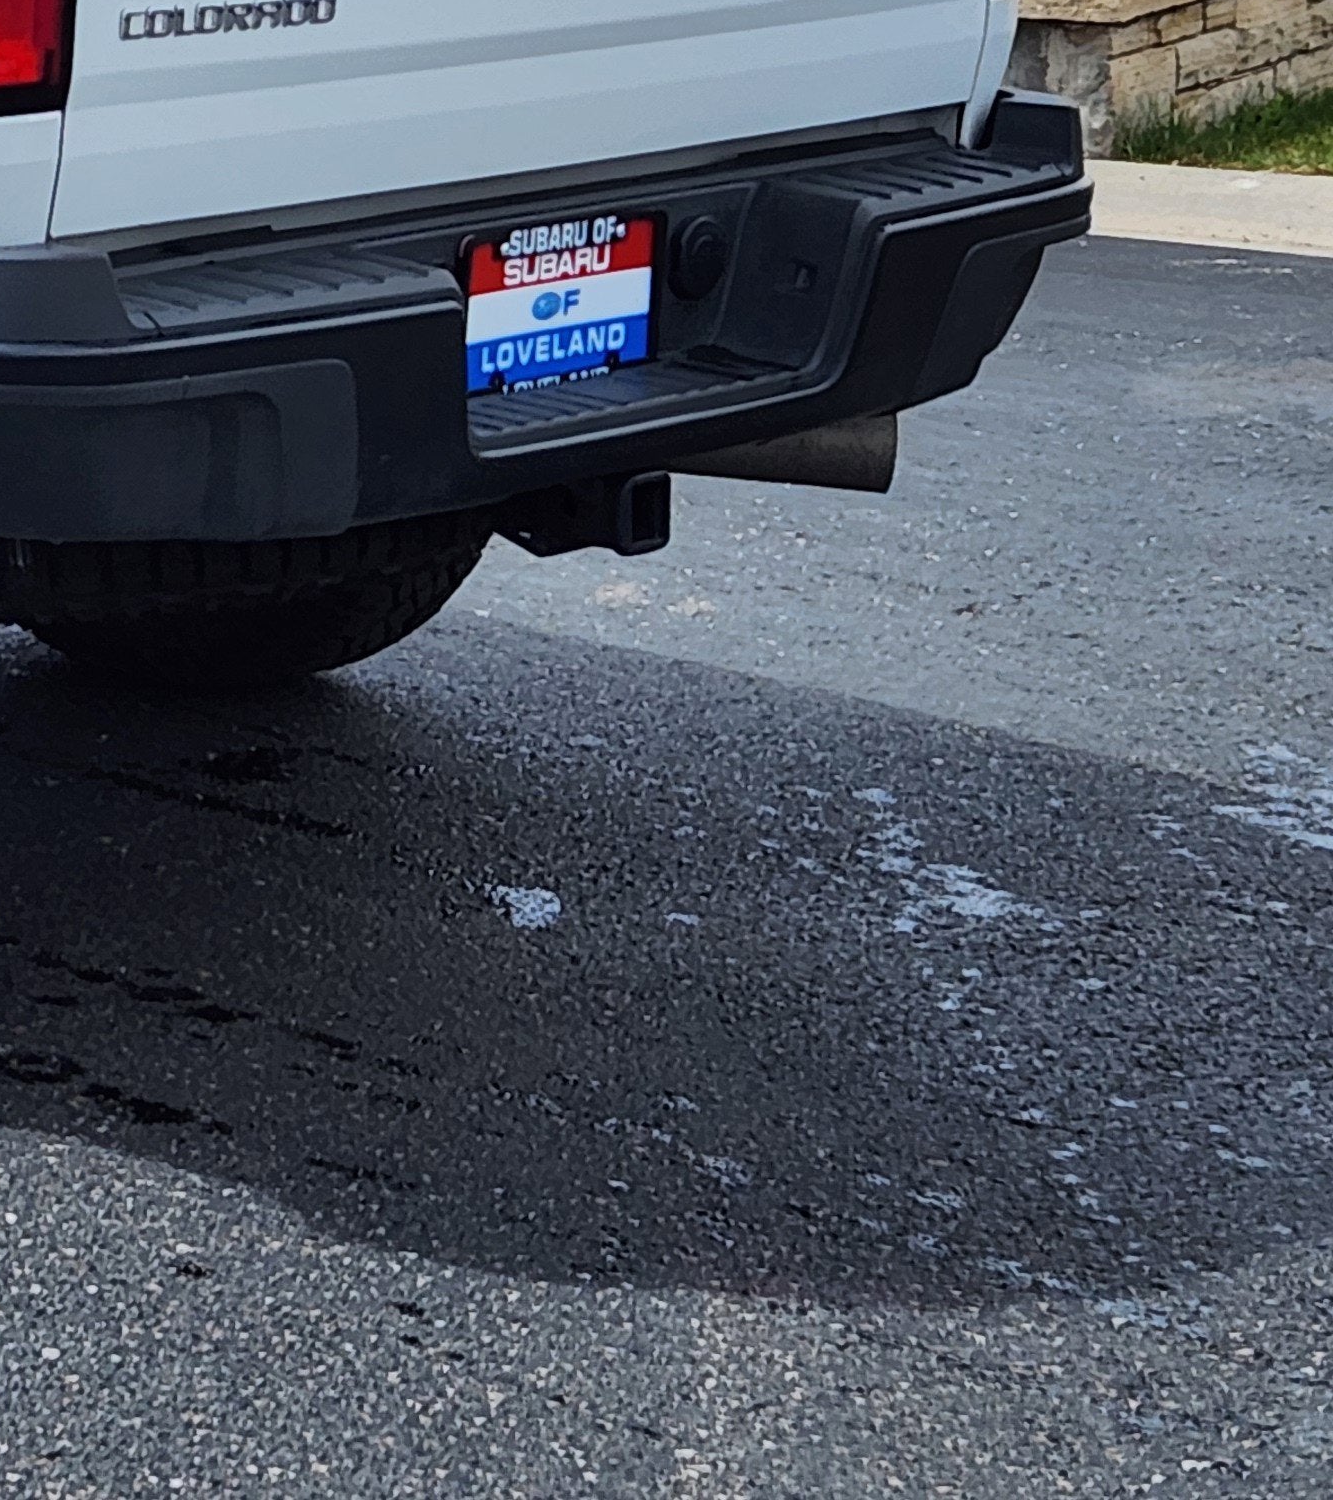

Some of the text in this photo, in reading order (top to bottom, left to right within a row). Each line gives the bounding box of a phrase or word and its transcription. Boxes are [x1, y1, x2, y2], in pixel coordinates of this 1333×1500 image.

[508, 215, 618, 257] SUBARU OF
[503, 245, 612, 287] SUBARU
[481, 322, 627, 374] LOVELAND
